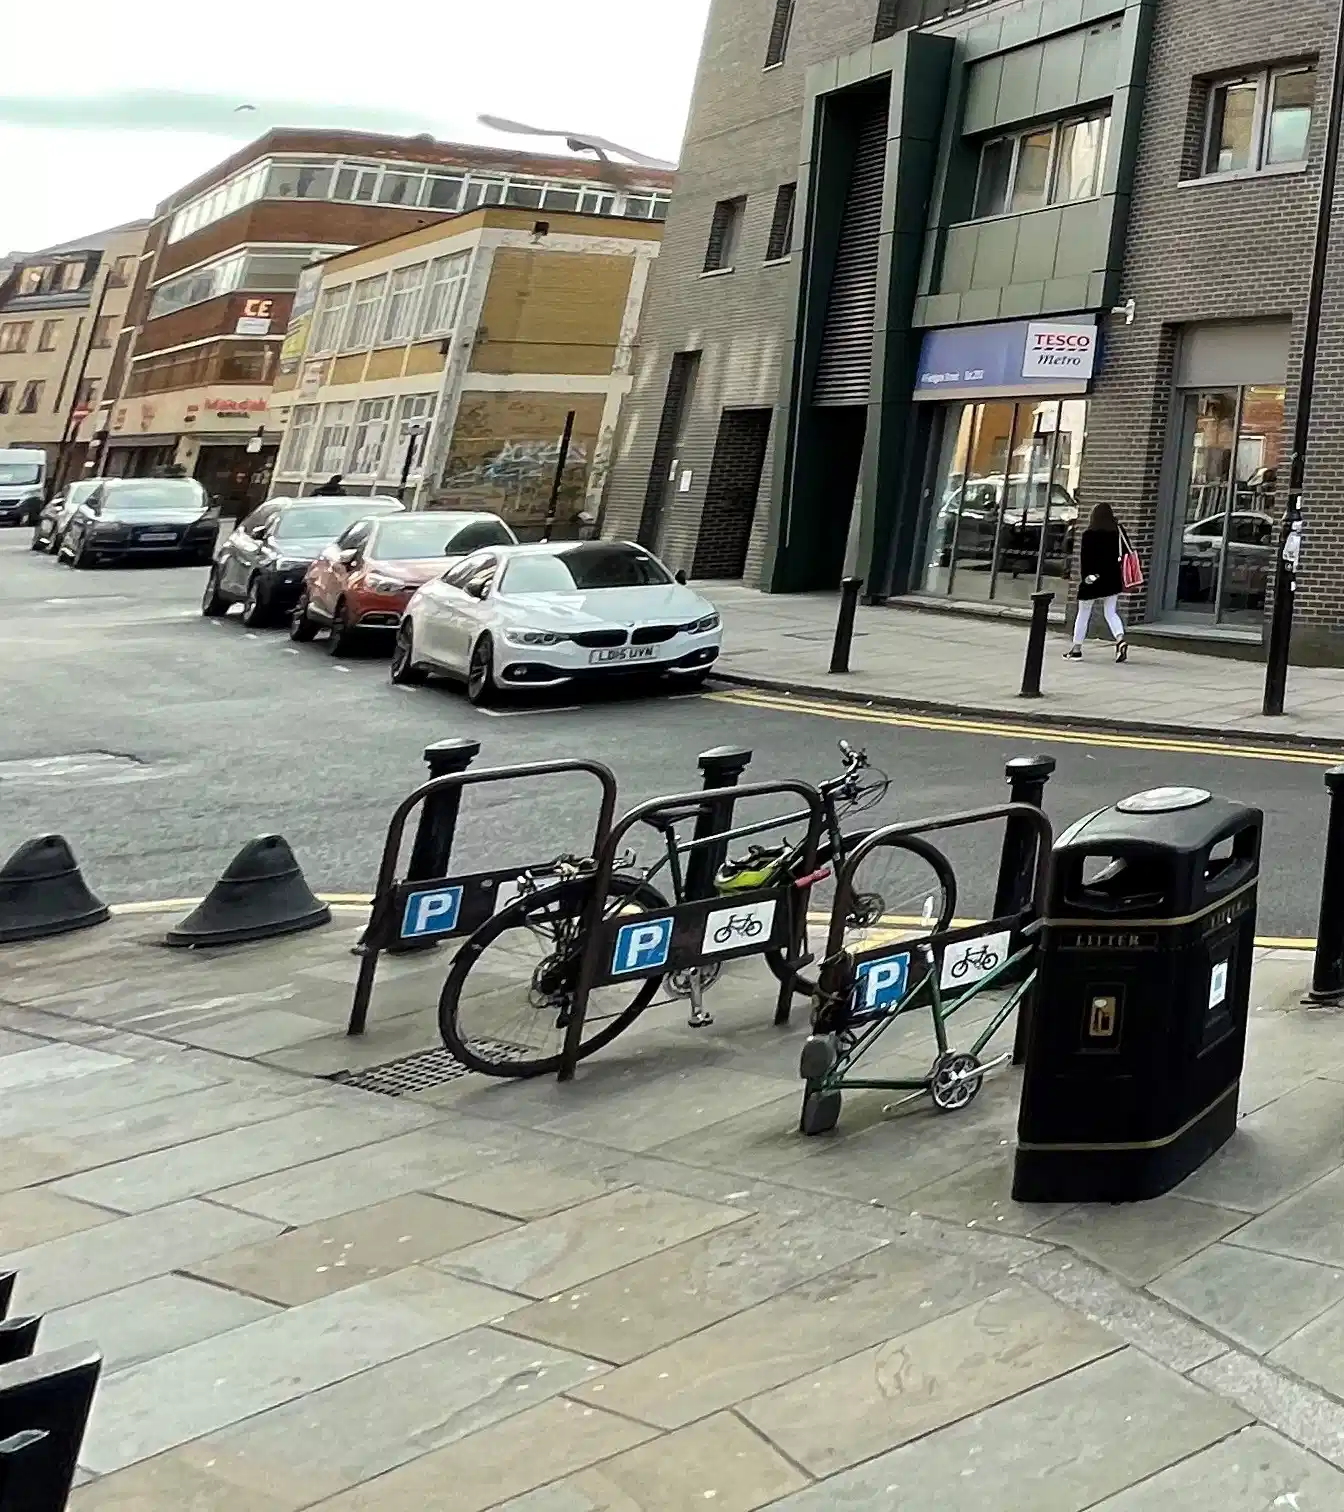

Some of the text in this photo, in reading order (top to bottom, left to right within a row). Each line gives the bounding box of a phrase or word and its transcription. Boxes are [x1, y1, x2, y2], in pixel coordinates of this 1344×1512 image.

[1033, 333, 1091, 347] TESCO
[1037, 353, 1082, 366] Metro
[413, 893, 453, 933] P
[625, 925, 664, 968] P
[1076, 935, 1139, 947] LITTER
[865, 961, 900, 1008] P
